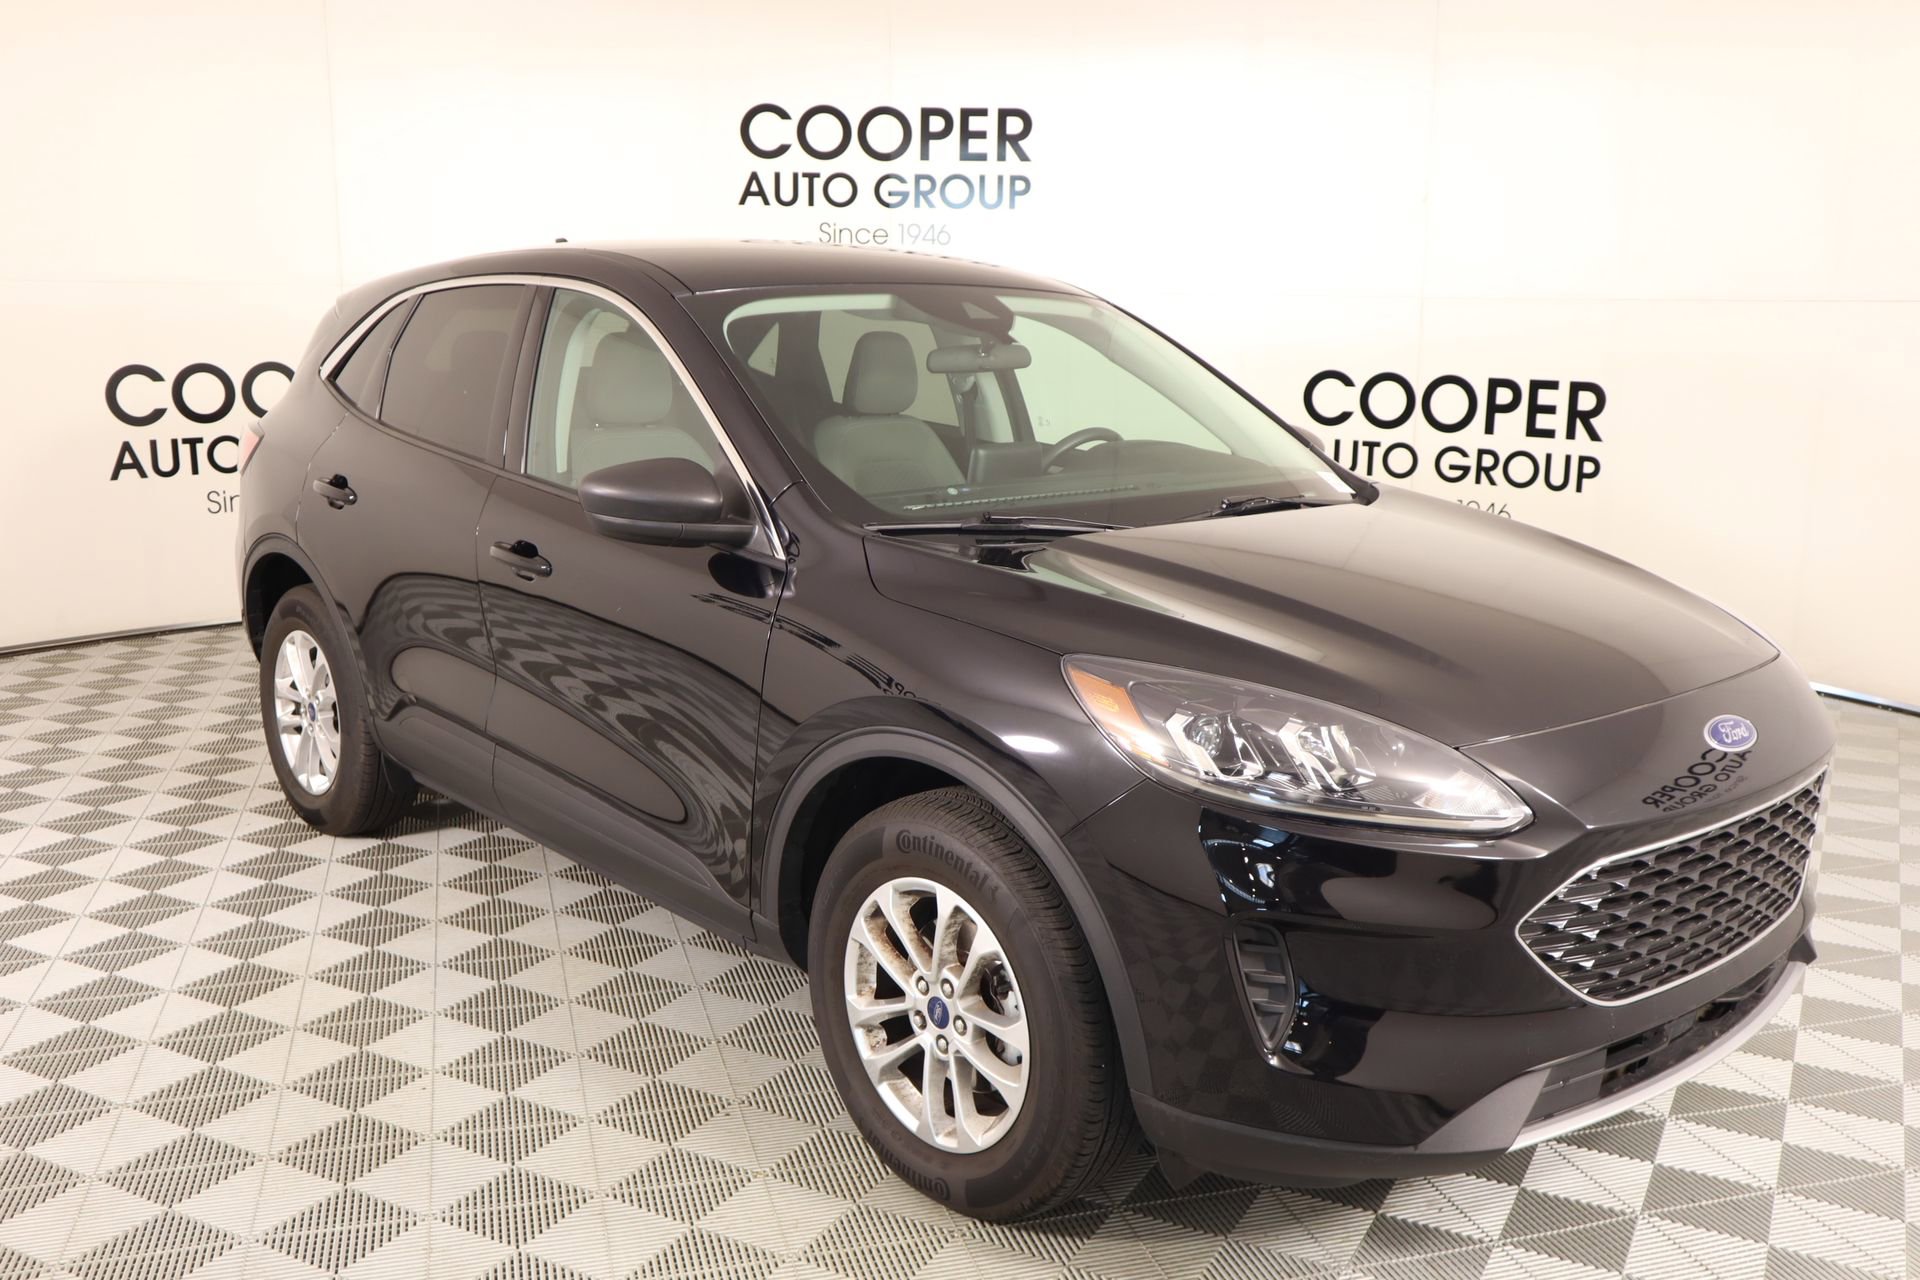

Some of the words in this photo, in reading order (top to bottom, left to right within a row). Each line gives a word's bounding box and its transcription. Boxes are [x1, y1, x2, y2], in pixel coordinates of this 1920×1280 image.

[740, 103, 1033, 162] COOPER
[738, 171, 858, 208] AUTO
[874, 173, 1032, 209] GROUP
[818, 222, 889, 245] Since
[898, 223, 952, 246] 1946
[105, 361, 296, 427] COO
[1303, 369, 1607, 443] COOPER
[110, 435, 240, 481] AUTO
[1333, 438, 1419, 480] UTO
[1434, 446, 1601, 494] GROUP
[1718, 721, 1749, 744] Ford
[895, 829, 990, 891] Continental
